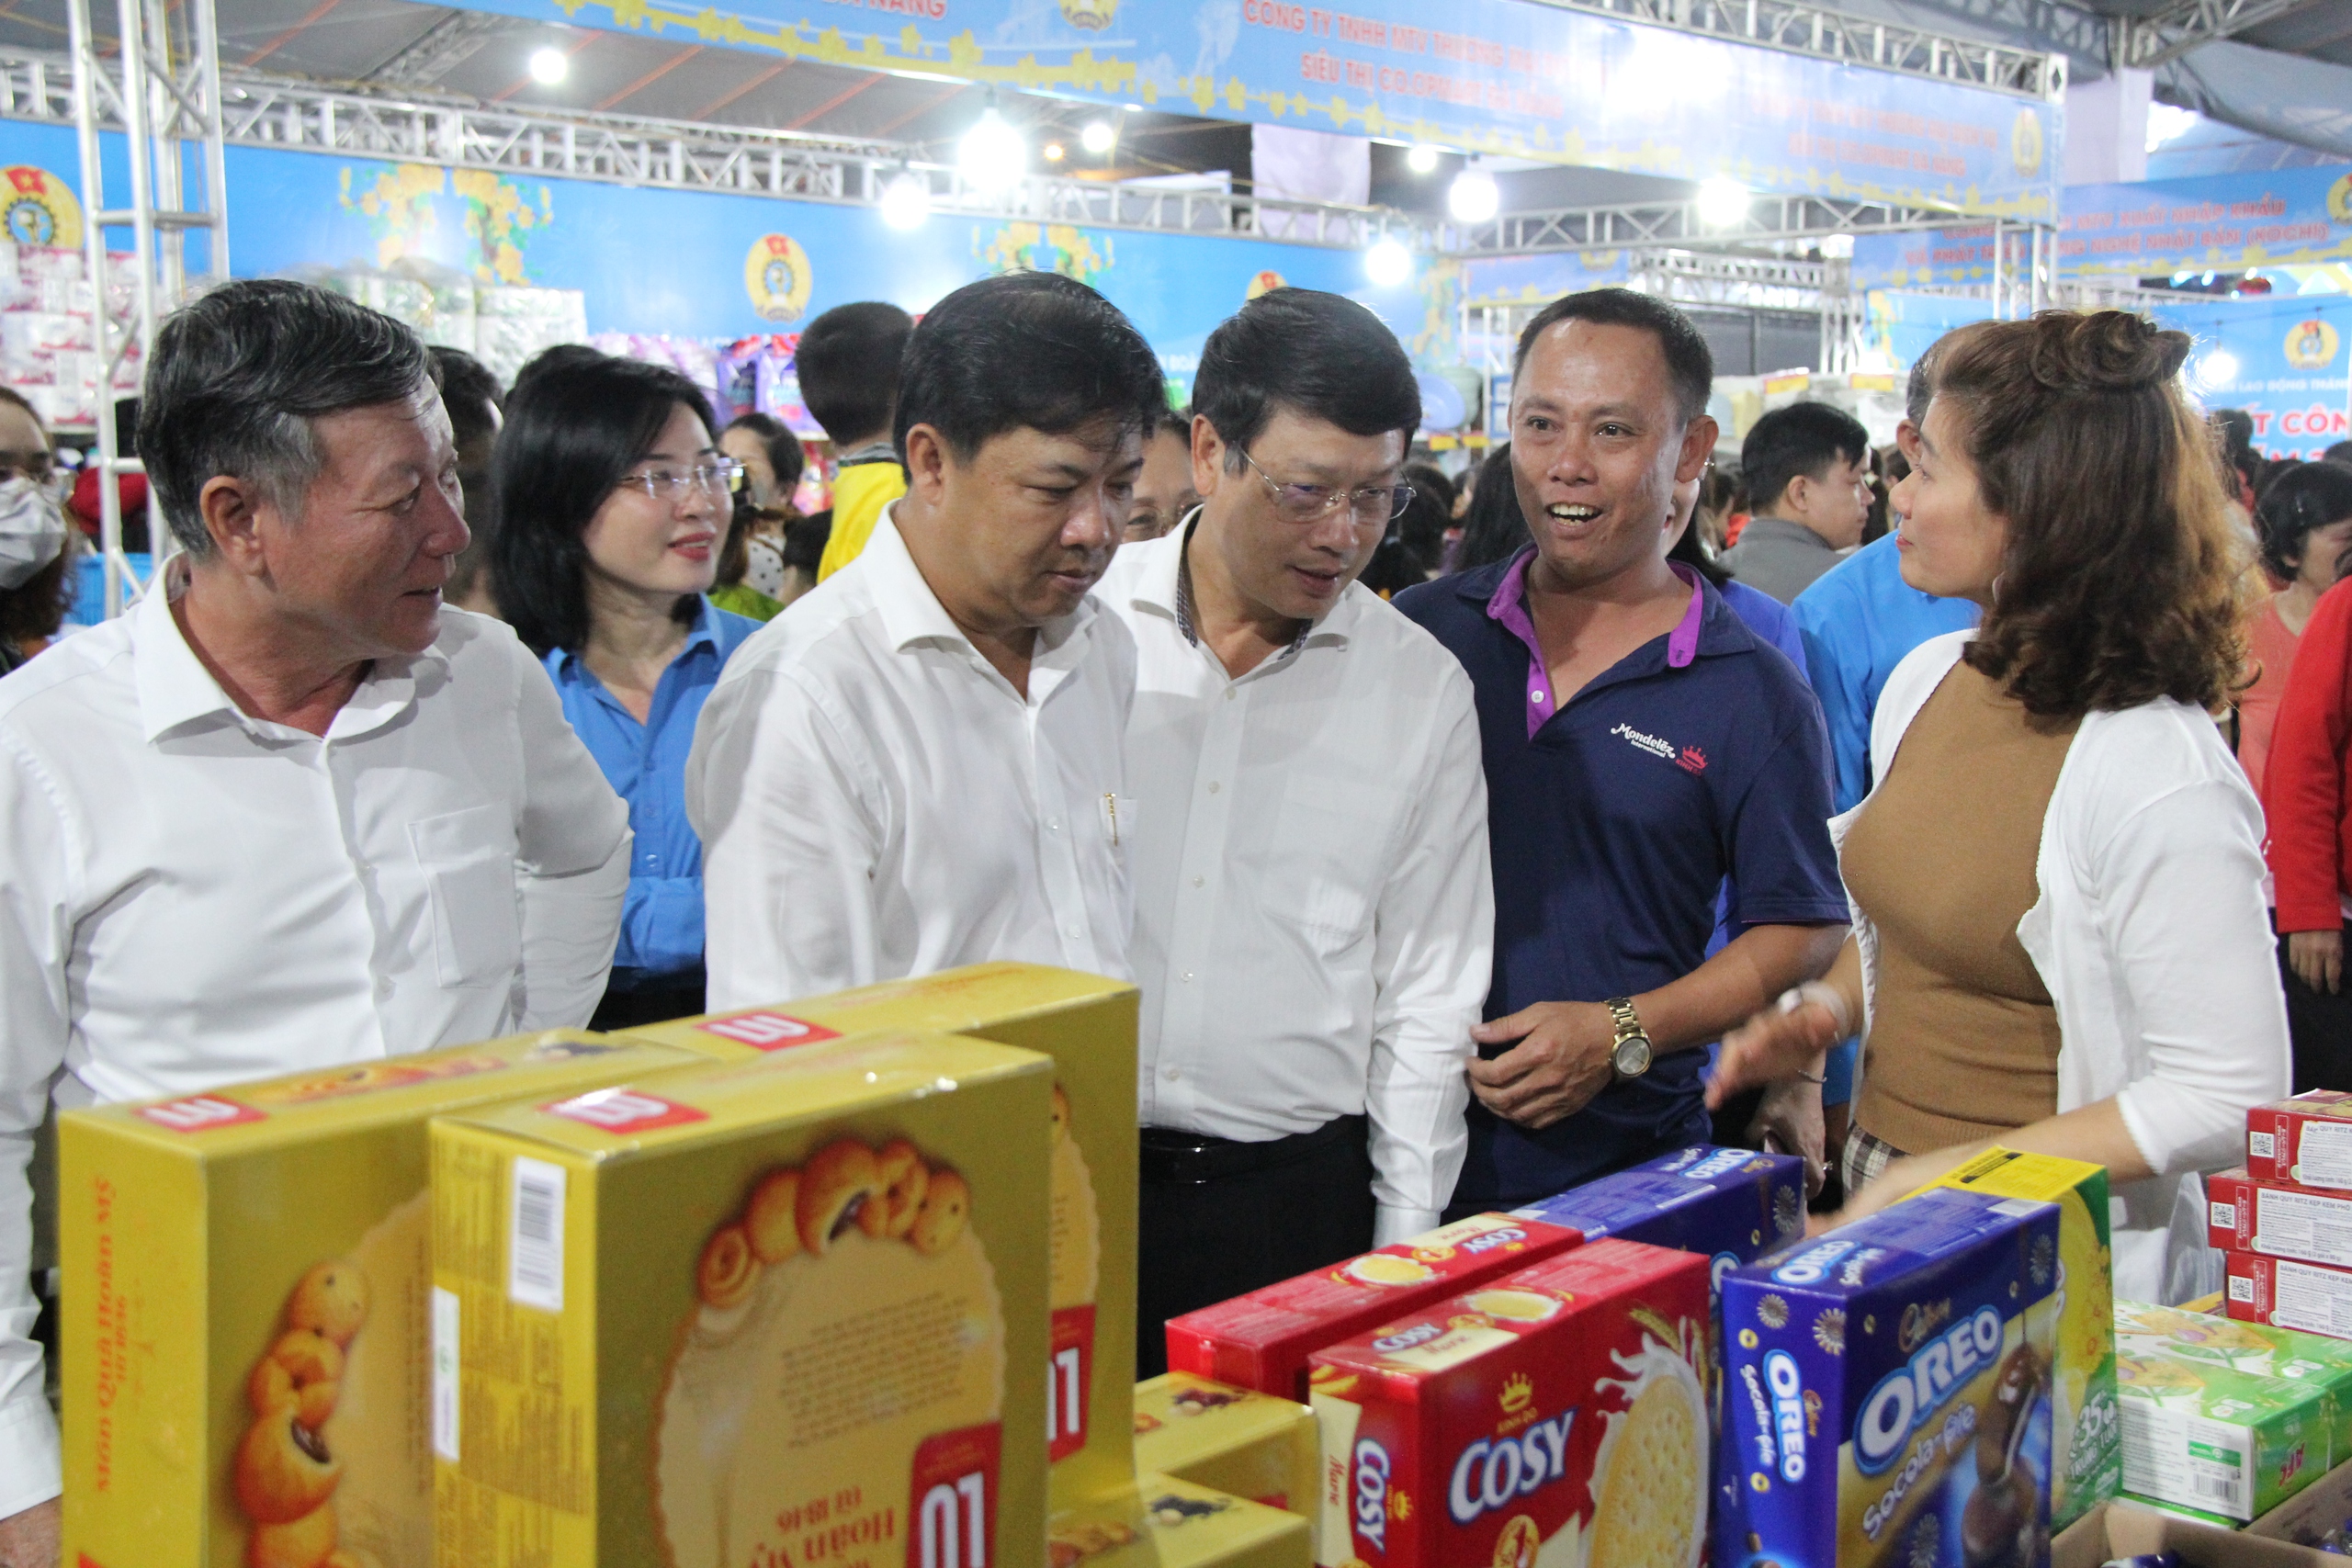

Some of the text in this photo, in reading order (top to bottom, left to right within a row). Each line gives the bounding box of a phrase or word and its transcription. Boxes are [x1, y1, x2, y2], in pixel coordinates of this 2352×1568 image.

[1310, 8, 1332, 38] TY
[1337, 14, 1387, 48] TNHH
[1768, 1353, 1805, 1480] OREO
[1858, 1308, 2001, 1463] OREO
[1356, 1438, 1390, 1554] COSY
[1449, 1408, 1577, 1525] COSY
